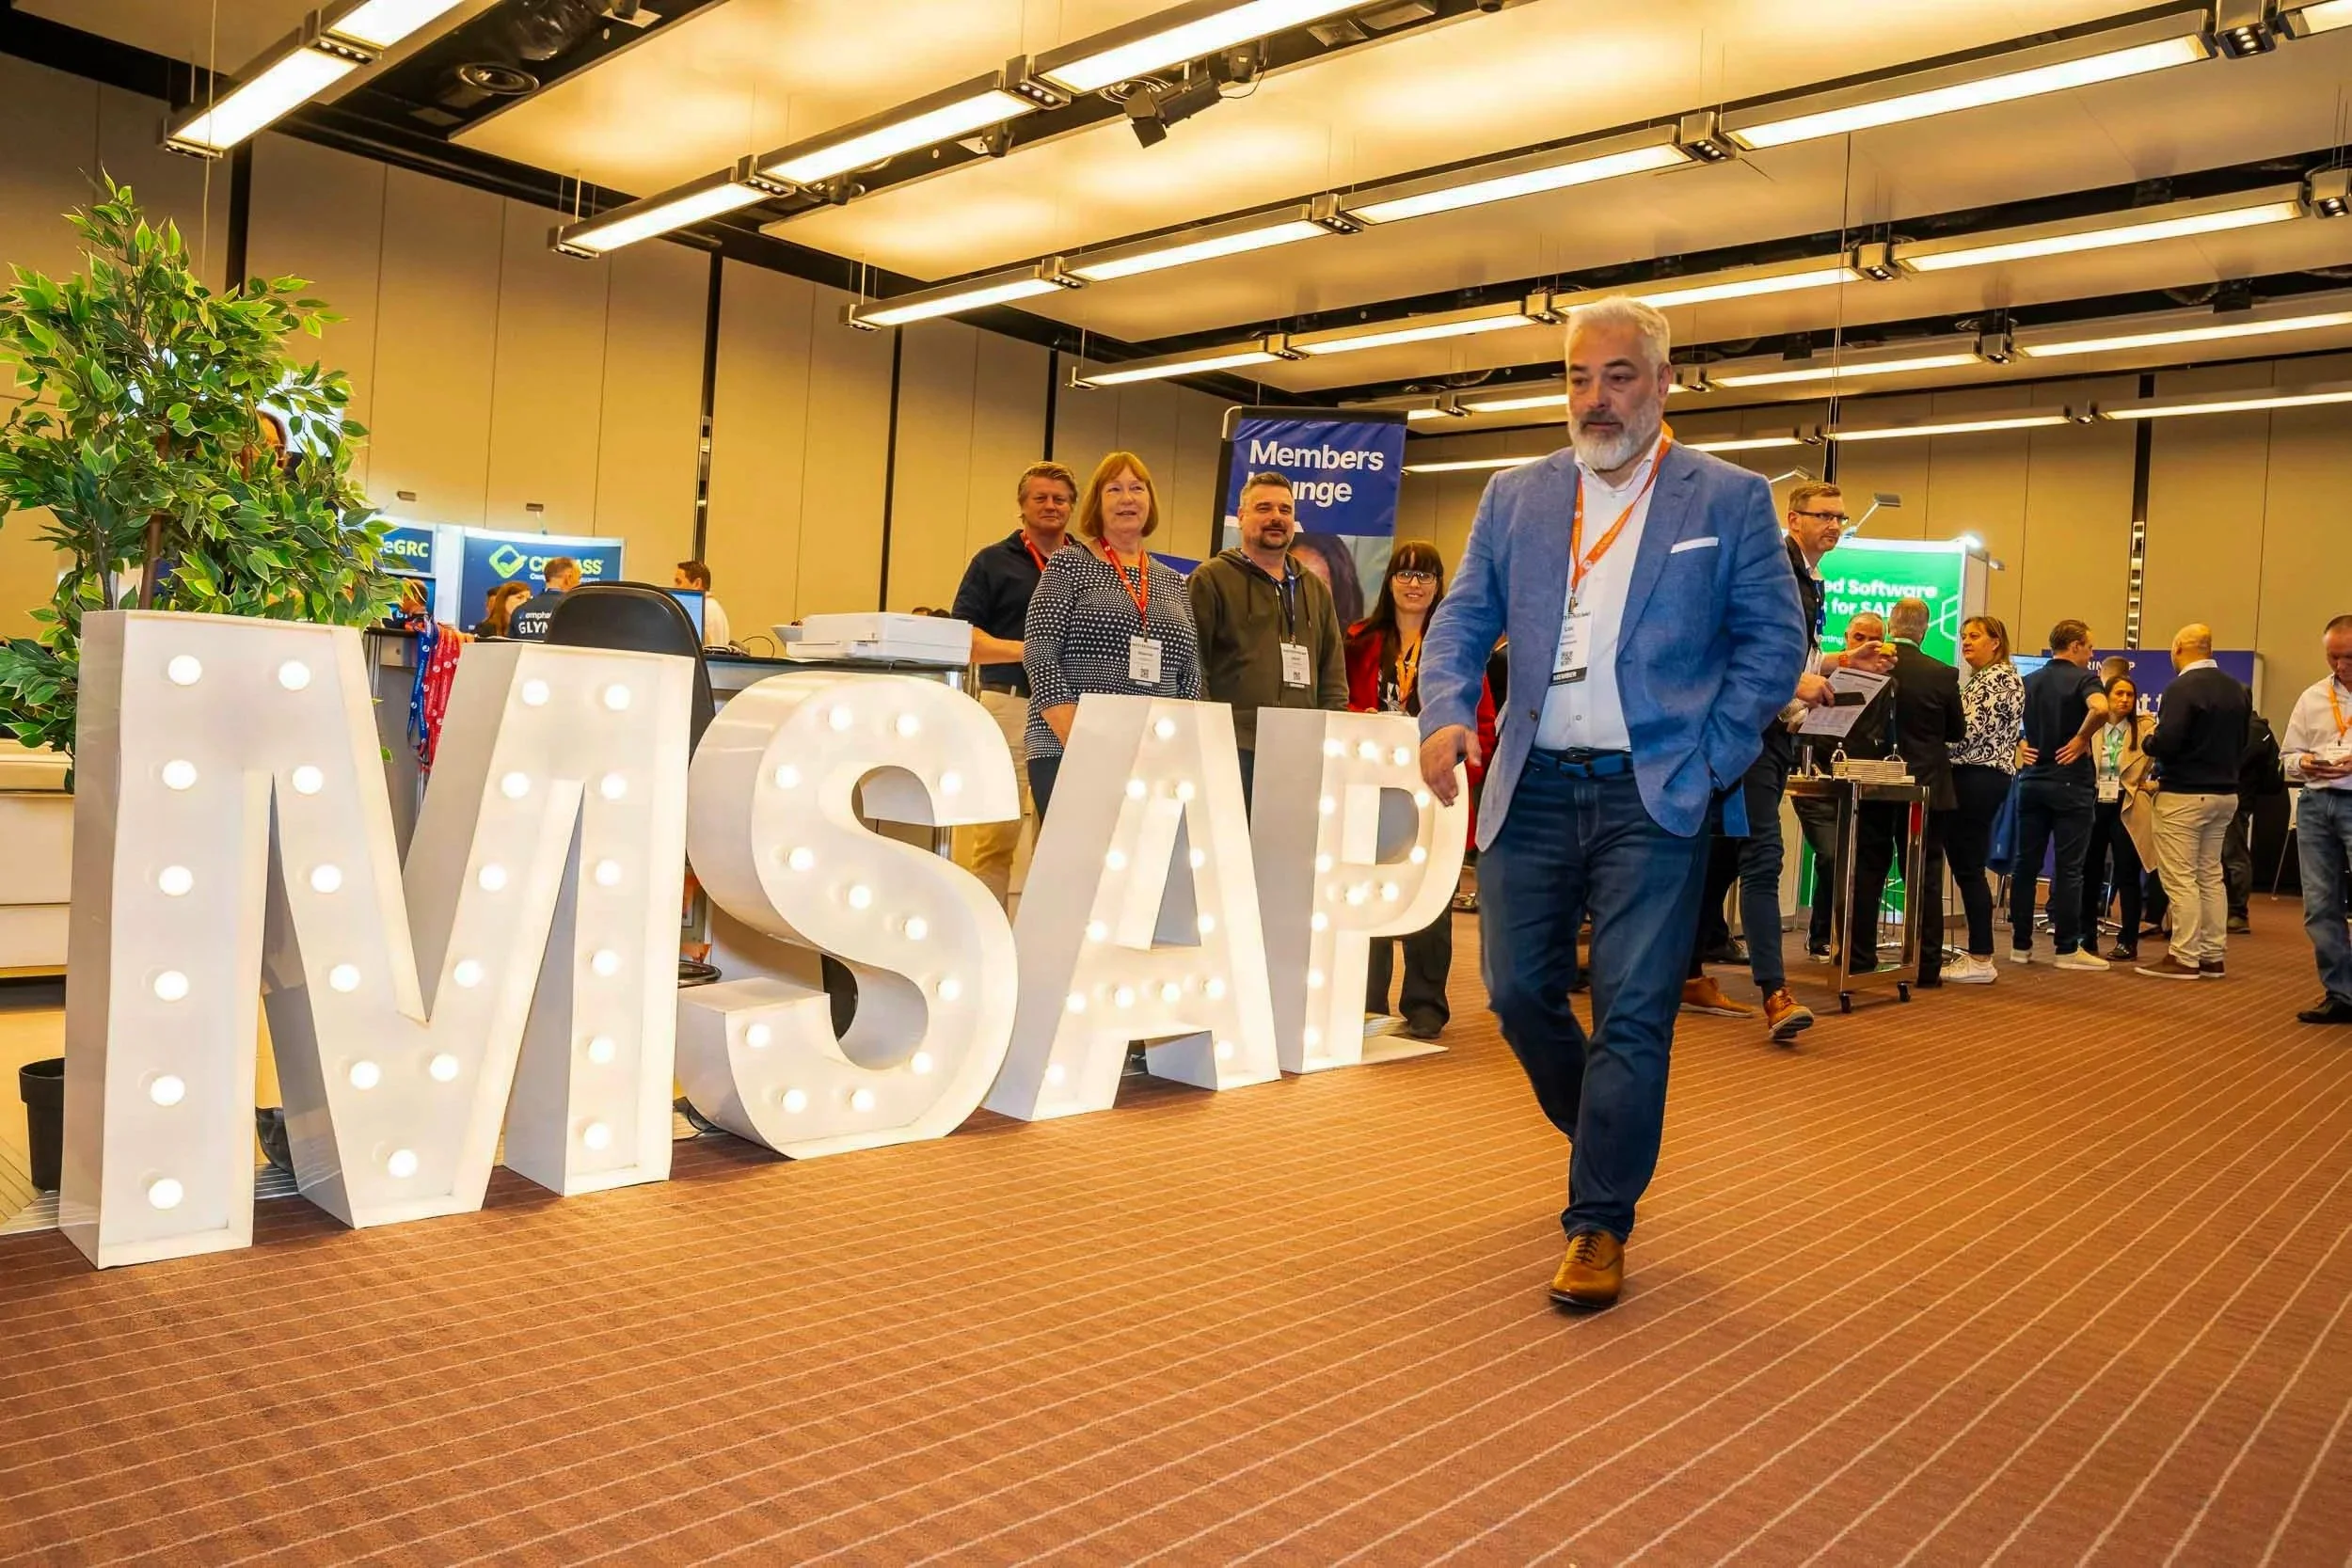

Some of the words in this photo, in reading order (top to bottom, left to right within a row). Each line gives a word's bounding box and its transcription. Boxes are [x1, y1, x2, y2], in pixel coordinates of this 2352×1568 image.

[1248, 439, 1385, 471] Members
[380, 539, 430, 558] eGRC
[1848, 578, 1937, 598] Software
[1831, 596, 1858, 614] for
[525, 611, 551, 621] empha
